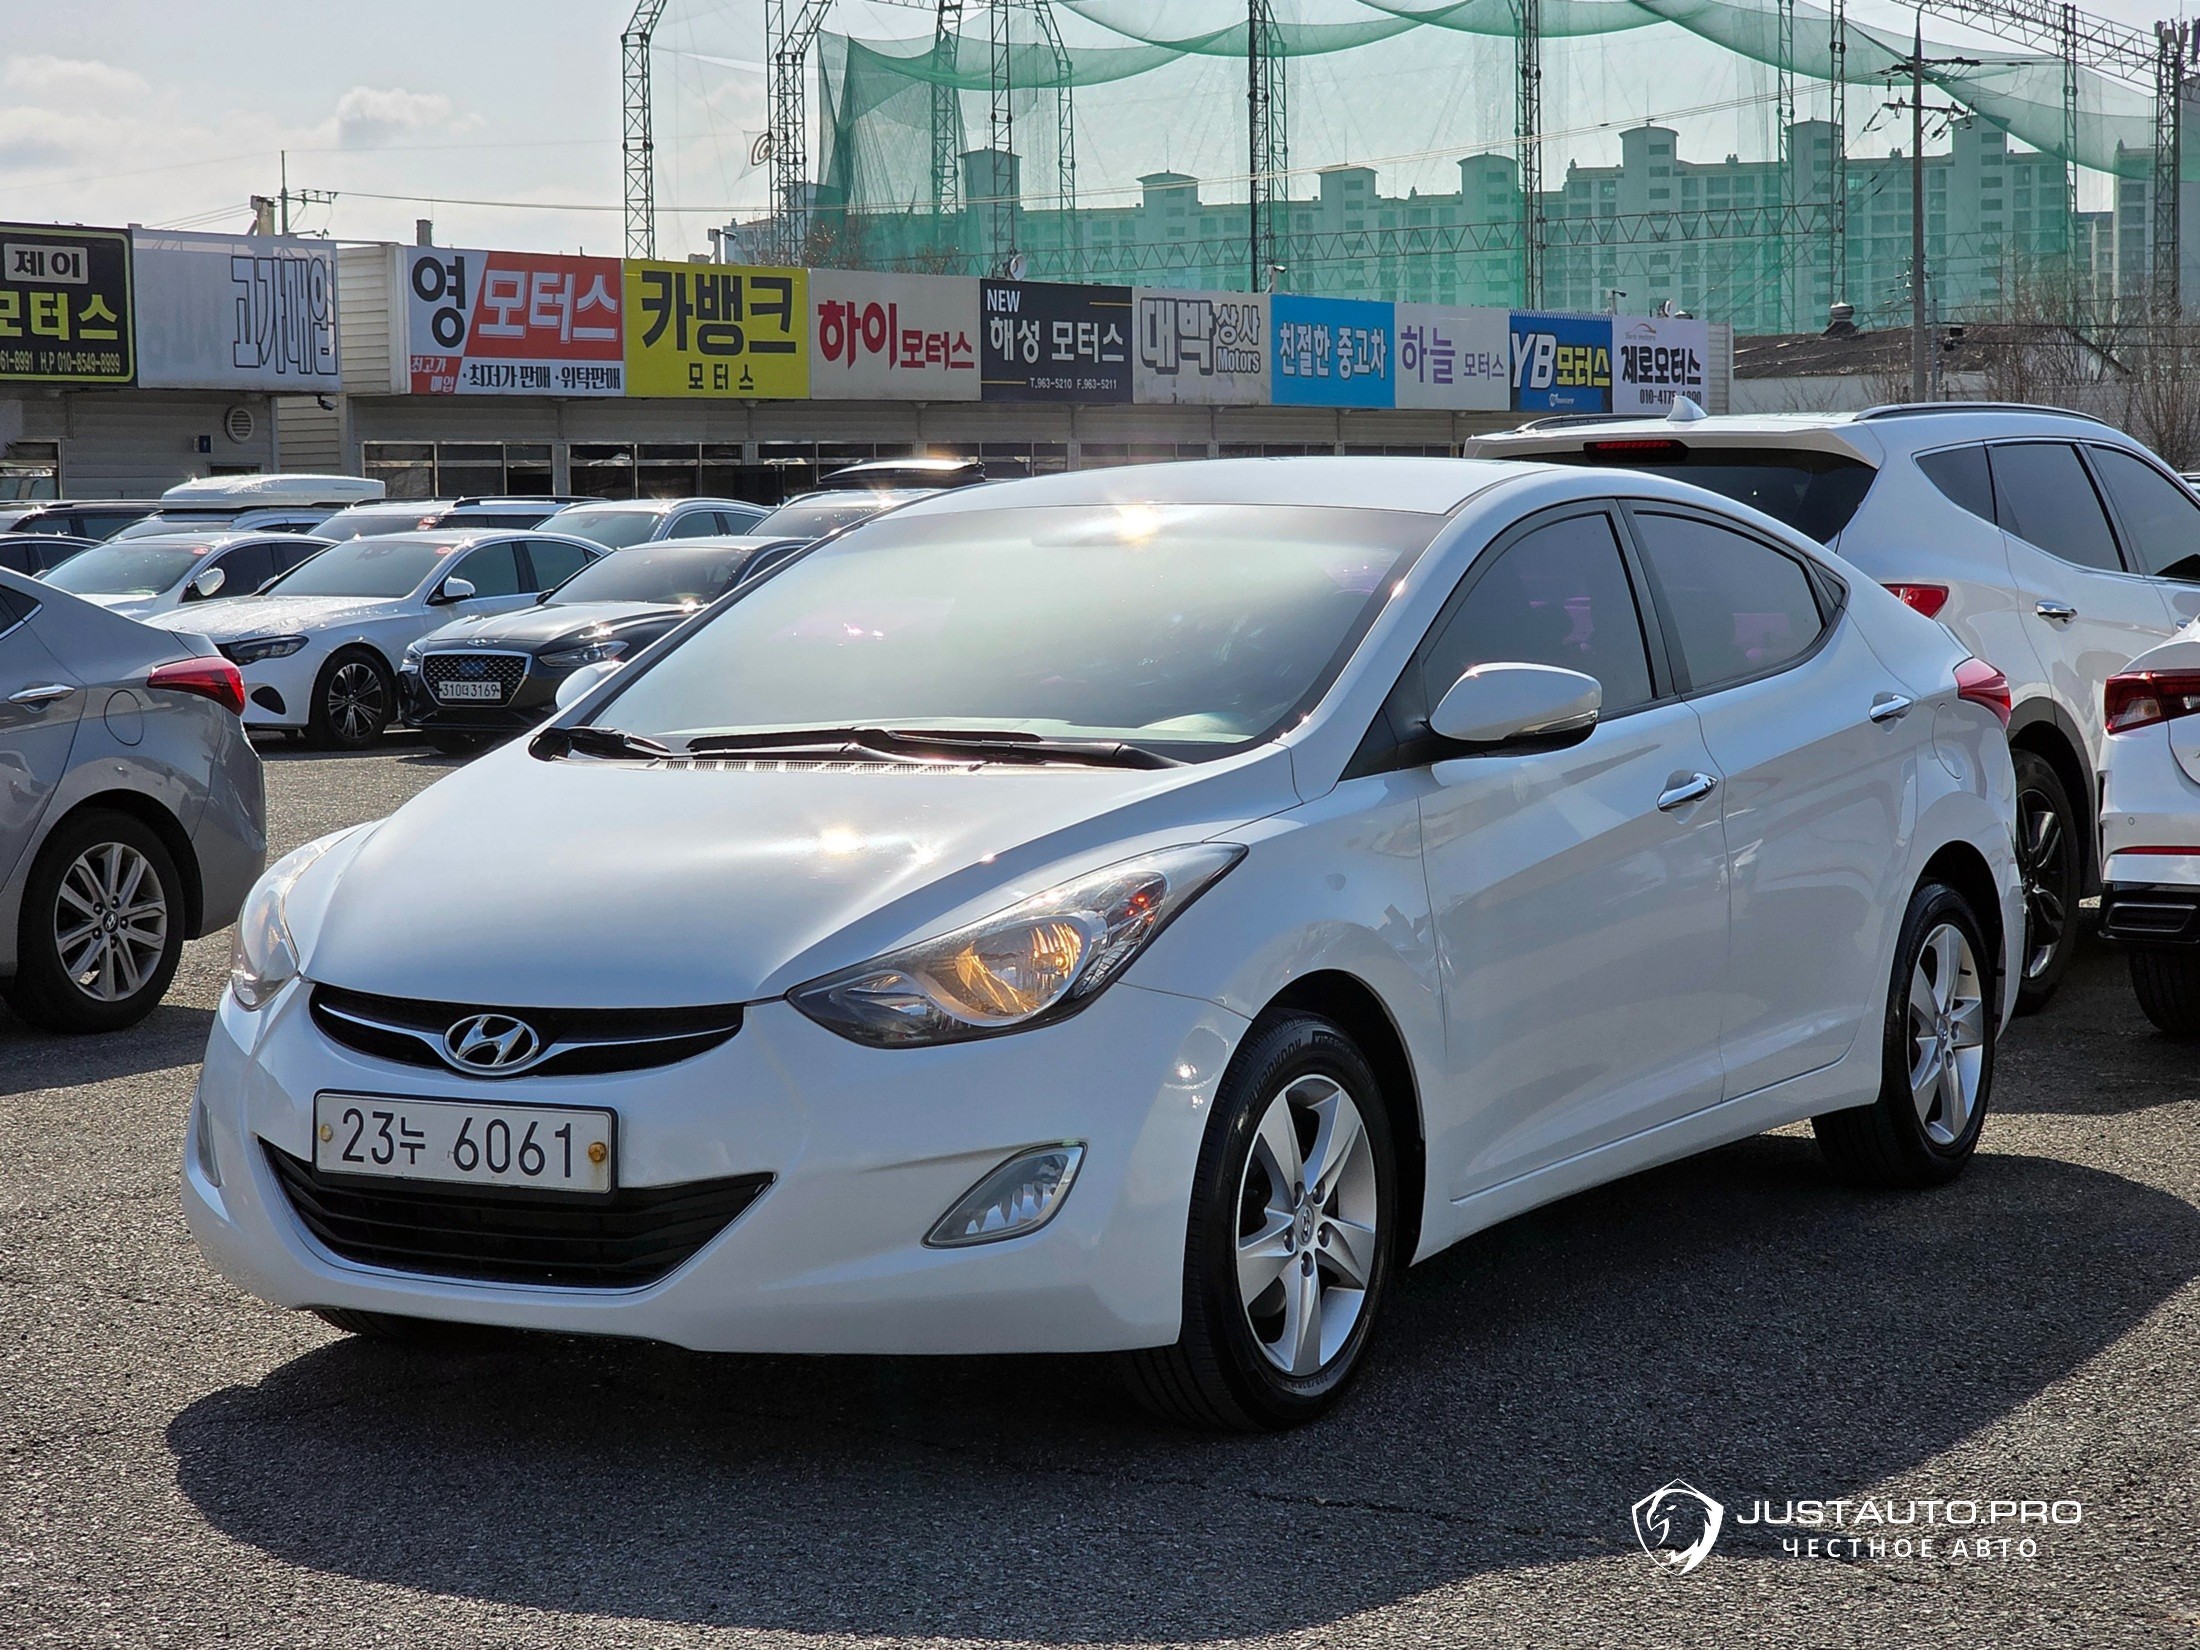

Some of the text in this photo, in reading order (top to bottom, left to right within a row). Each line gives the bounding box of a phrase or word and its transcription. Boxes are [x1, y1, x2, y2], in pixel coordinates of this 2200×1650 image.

[14, 250, 80, 278] 제이
[412, 256, 618, 348] 영 모터스
[641, 270, 797, 356] 카뱅크
[987, 289, 1020, 312] NEW
[817, 300, 975, 370] 하이 모터스
[989, 317, 1125, 364] 해성 모터스
[1140, 298, 1260, 376] 대박 상사
[1279, 321, 1387, 379] 친절한 중고차
[1400, 325, 1505, 384] 하늘 모터스
[411, 356, 447, 373] 최고가
[430, 375, 455, 393] 매입
[469, 364, 620, 390] 최저가 판매 위탁판매
[688, 363, 755, 390] 모터스
[1217, 347, 1260, 374] Motors
[1511, 332, 1611, 389] YB 모터스
[1620, 345, 1702, 386] 제로모터스
[341, 1107, 572, 1179] 23누 6061
